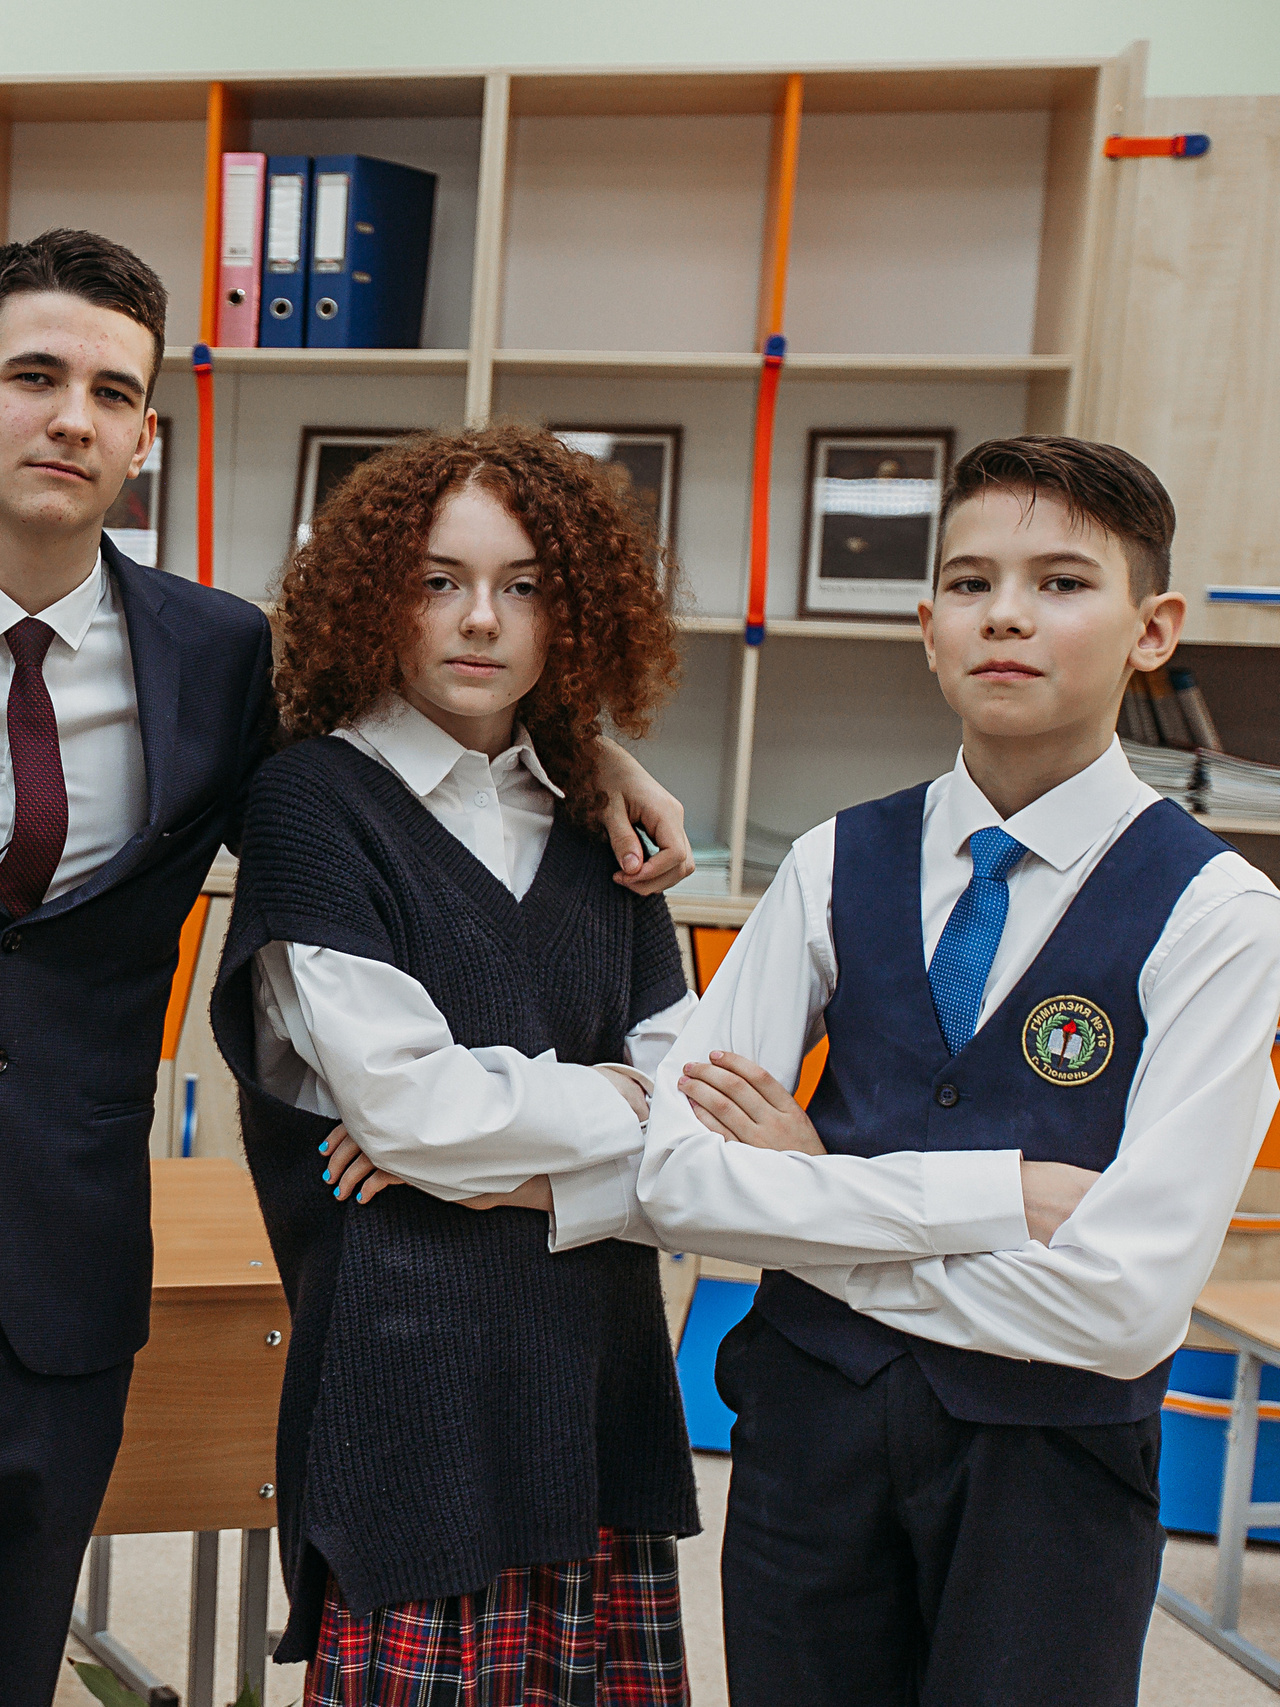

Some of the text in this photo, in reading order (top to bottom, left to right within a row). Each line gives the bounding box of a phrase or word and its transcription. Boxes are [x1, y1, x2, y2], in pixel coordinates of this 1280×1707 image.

[1030, 1001, 1107, 1048] ГИМНАЗИЯ № 16
[1042, 1062, 1089, 1080] Тюмень
